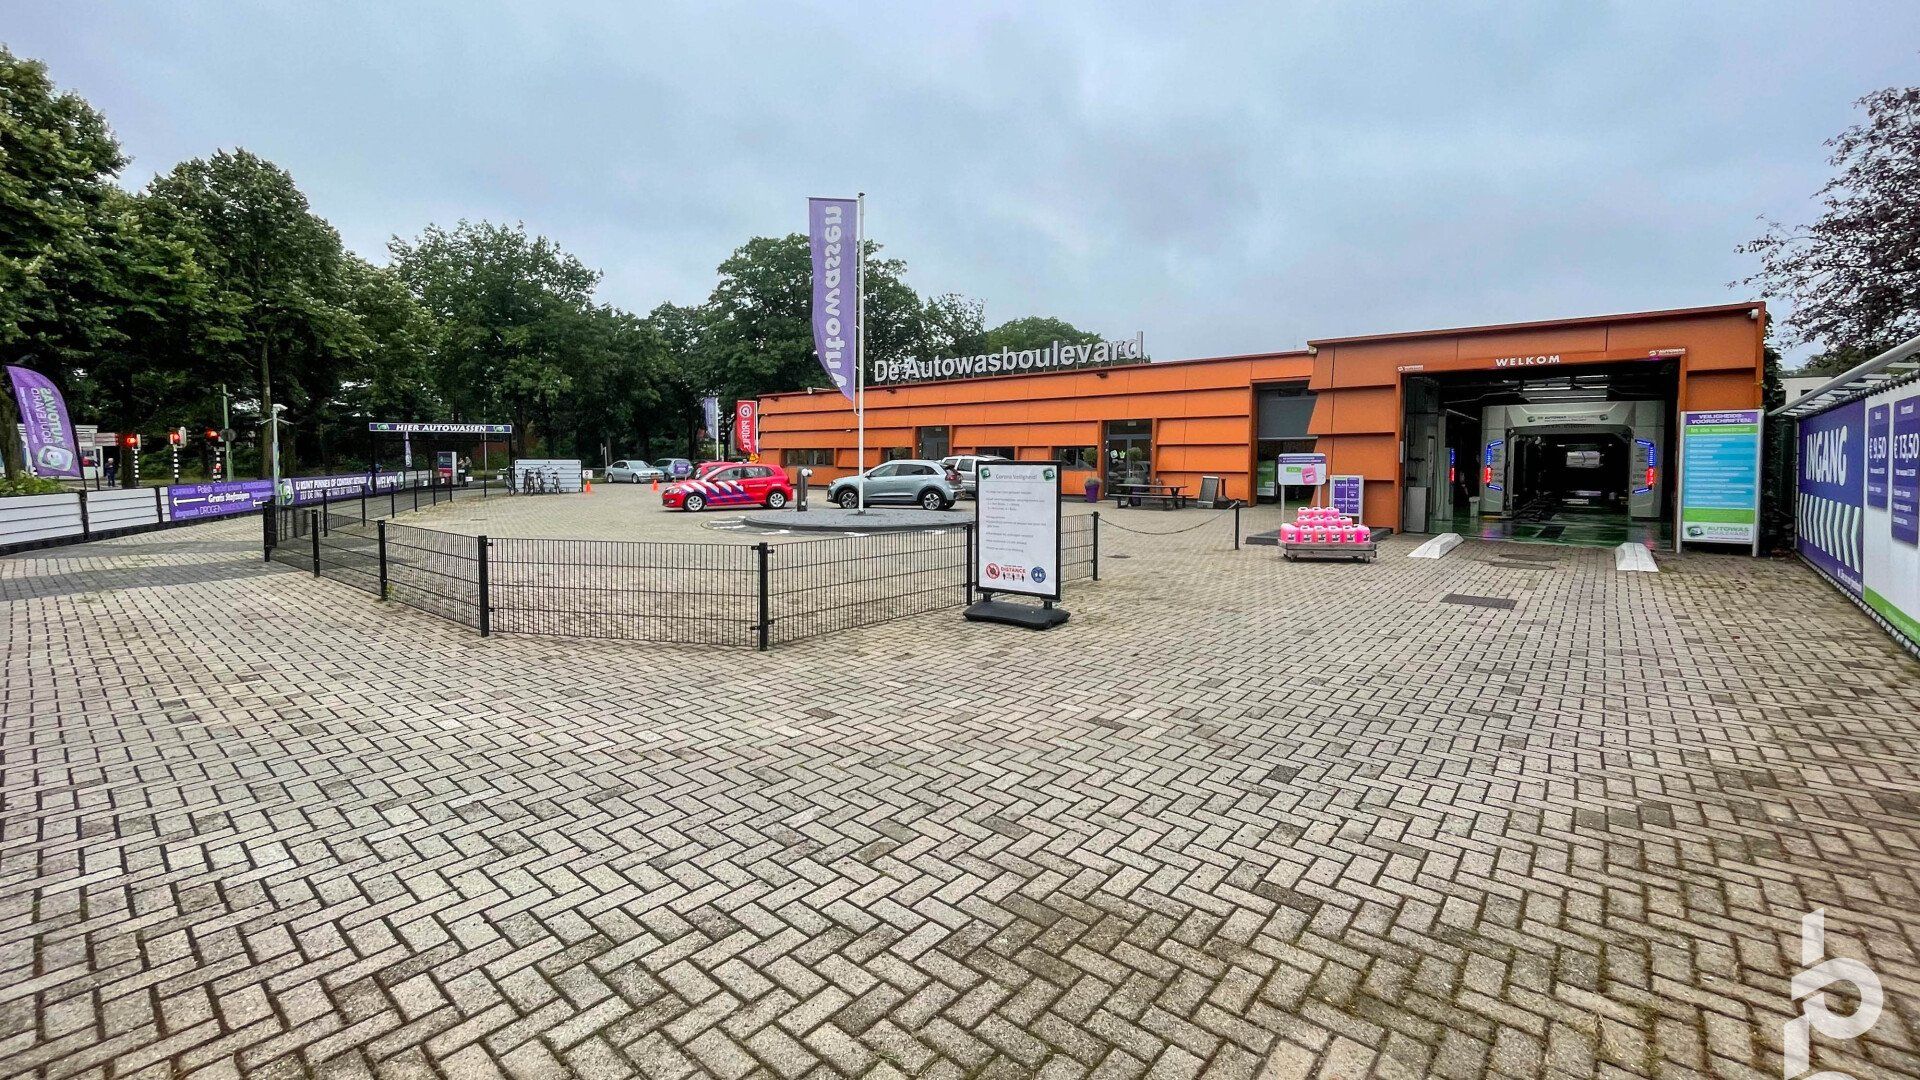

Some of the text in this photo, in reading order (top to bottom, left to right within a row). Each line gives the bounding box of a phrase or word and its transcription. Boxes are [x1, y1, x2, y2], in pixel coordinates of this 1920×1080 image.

[874, 331, 1144, 382] De Autowasboulevard
[1495, 355, 1560, 367] WELKOM
[422, 424, 486, 432] AUTOWASSEN
[1806, 425, 1848, 486] INGANG
